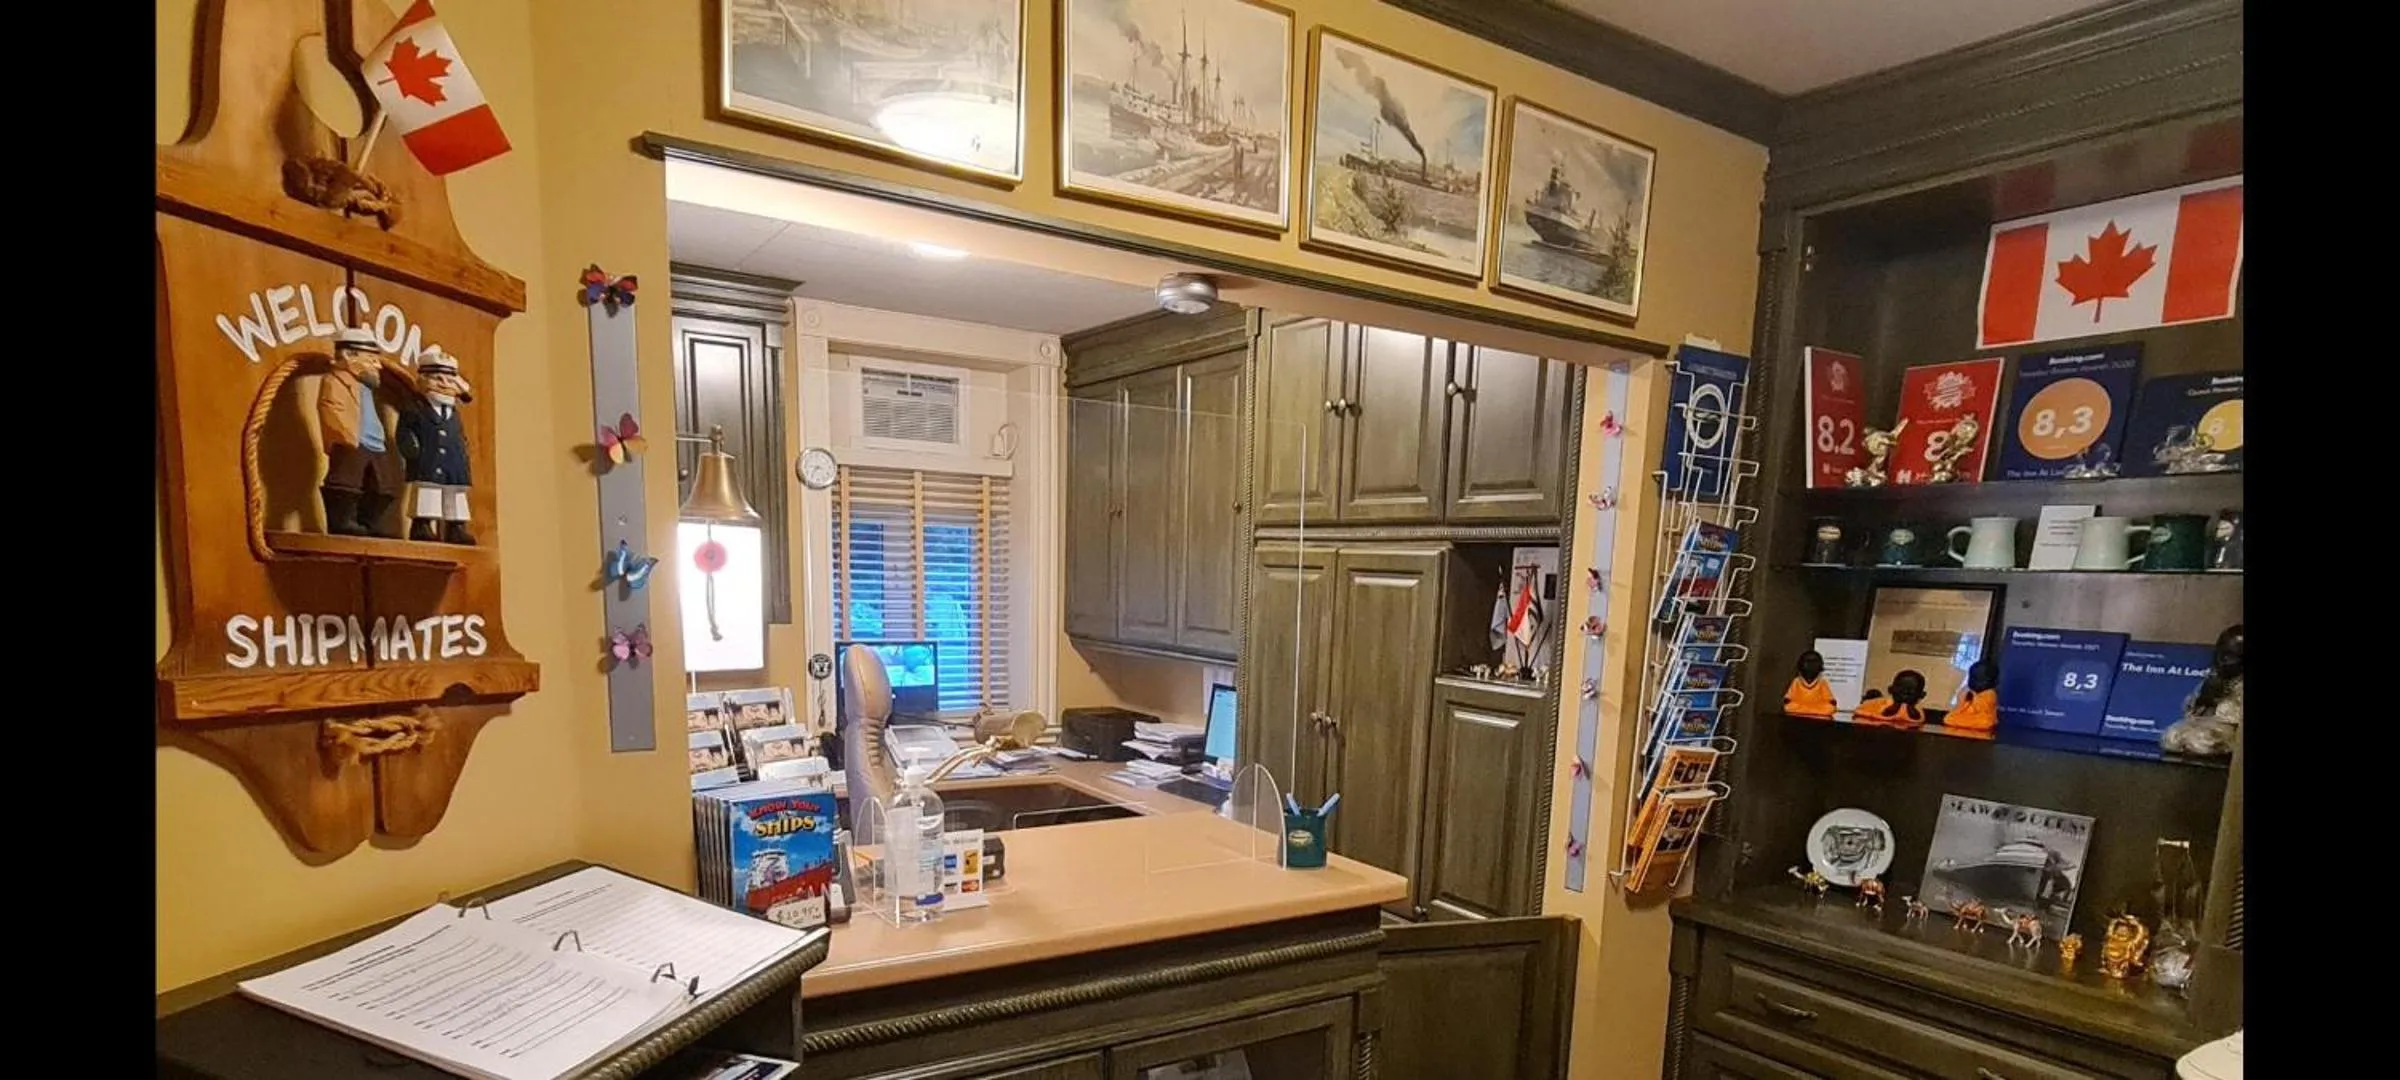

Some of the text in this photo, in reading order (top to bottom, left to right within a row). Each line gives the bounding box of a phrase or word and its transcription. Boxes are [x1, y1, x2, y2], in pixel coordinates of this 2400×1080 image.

[2032, 406, 2093, 439] 8,3
[1817, 415, 1855, 455] 8.2
[225, 613, 488, 669] SHIPMATES
[2121, 661, 2143, 672] The
[2145, 663, 2165, 674] Inn
[2167, 665, 2182, 676] At
[2063, 672, 2098, 691] 8,3
[748, 801, 788, 818] KNOW
[792, 800, 820, 812] YOUR
[755, 815, 818, 837] SHIPS
